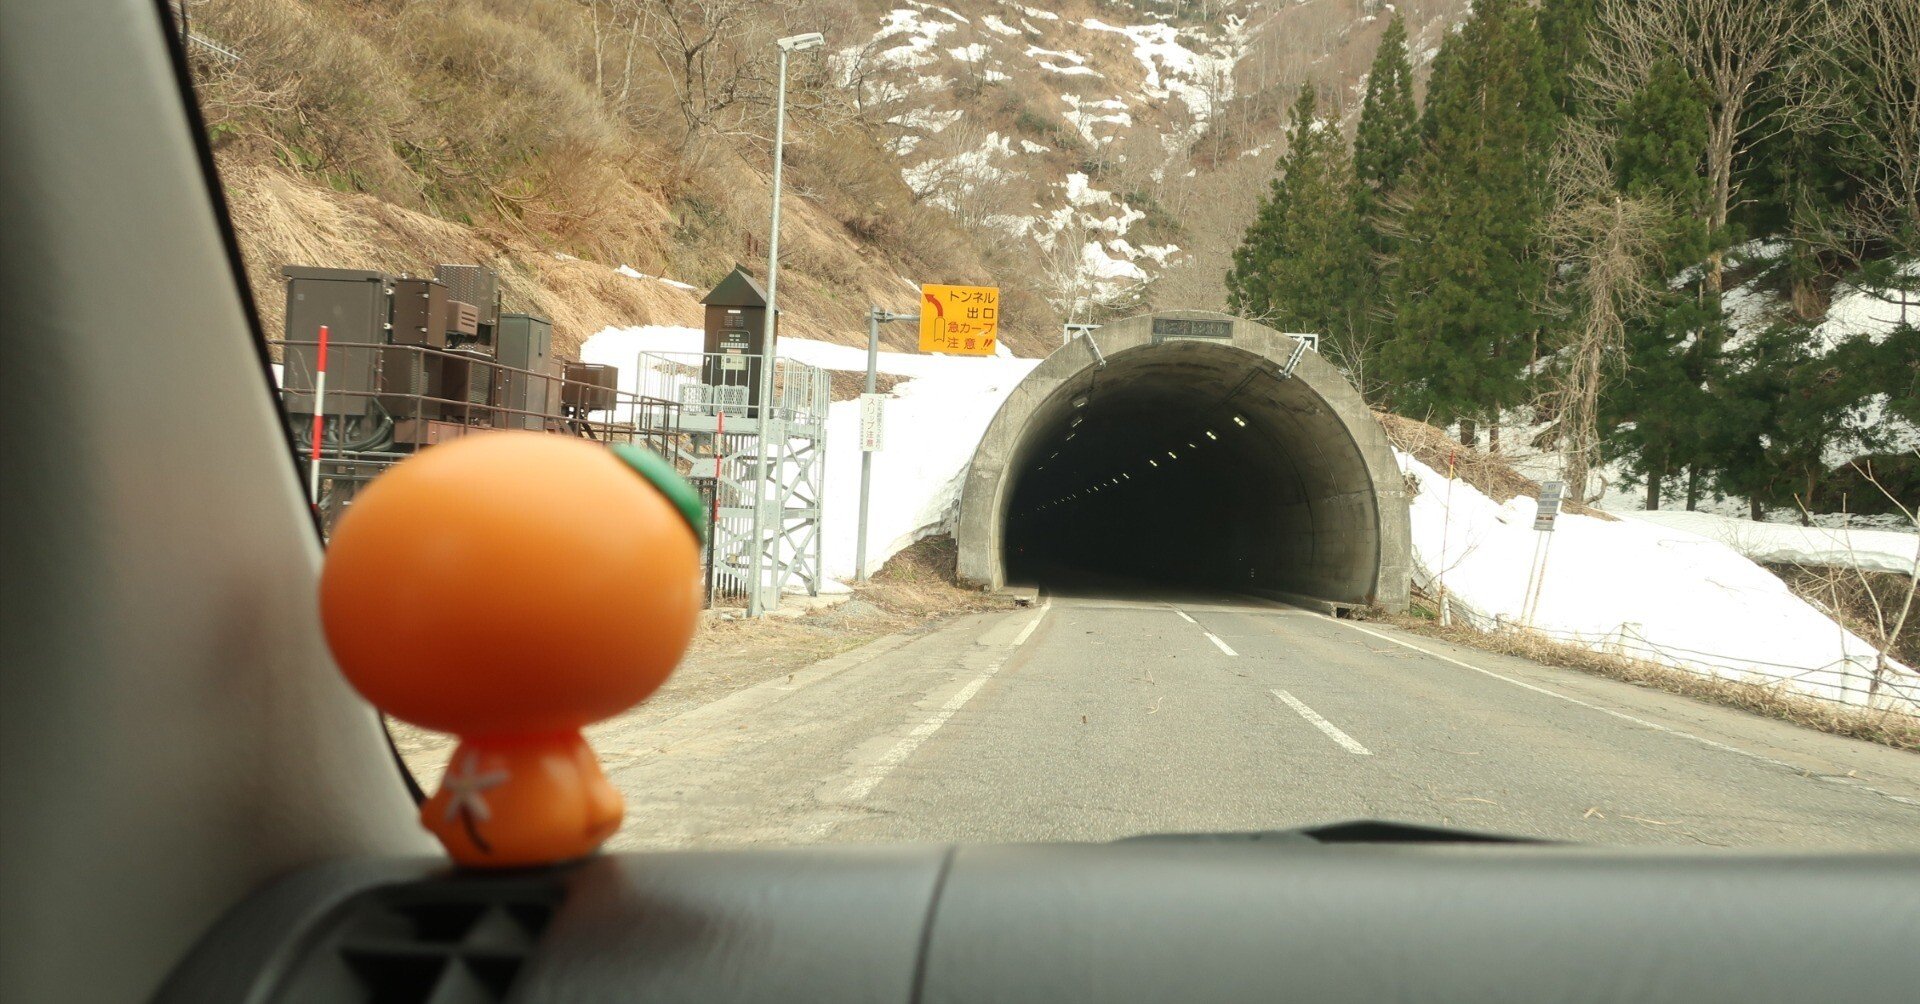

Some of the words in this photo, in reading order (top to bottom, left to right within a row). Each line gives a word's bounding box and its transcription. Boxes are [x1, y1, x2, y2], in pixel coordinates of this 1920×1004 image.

[950, 290, 995, 303] トンネル
[967, 307, 994, 319] 出口
